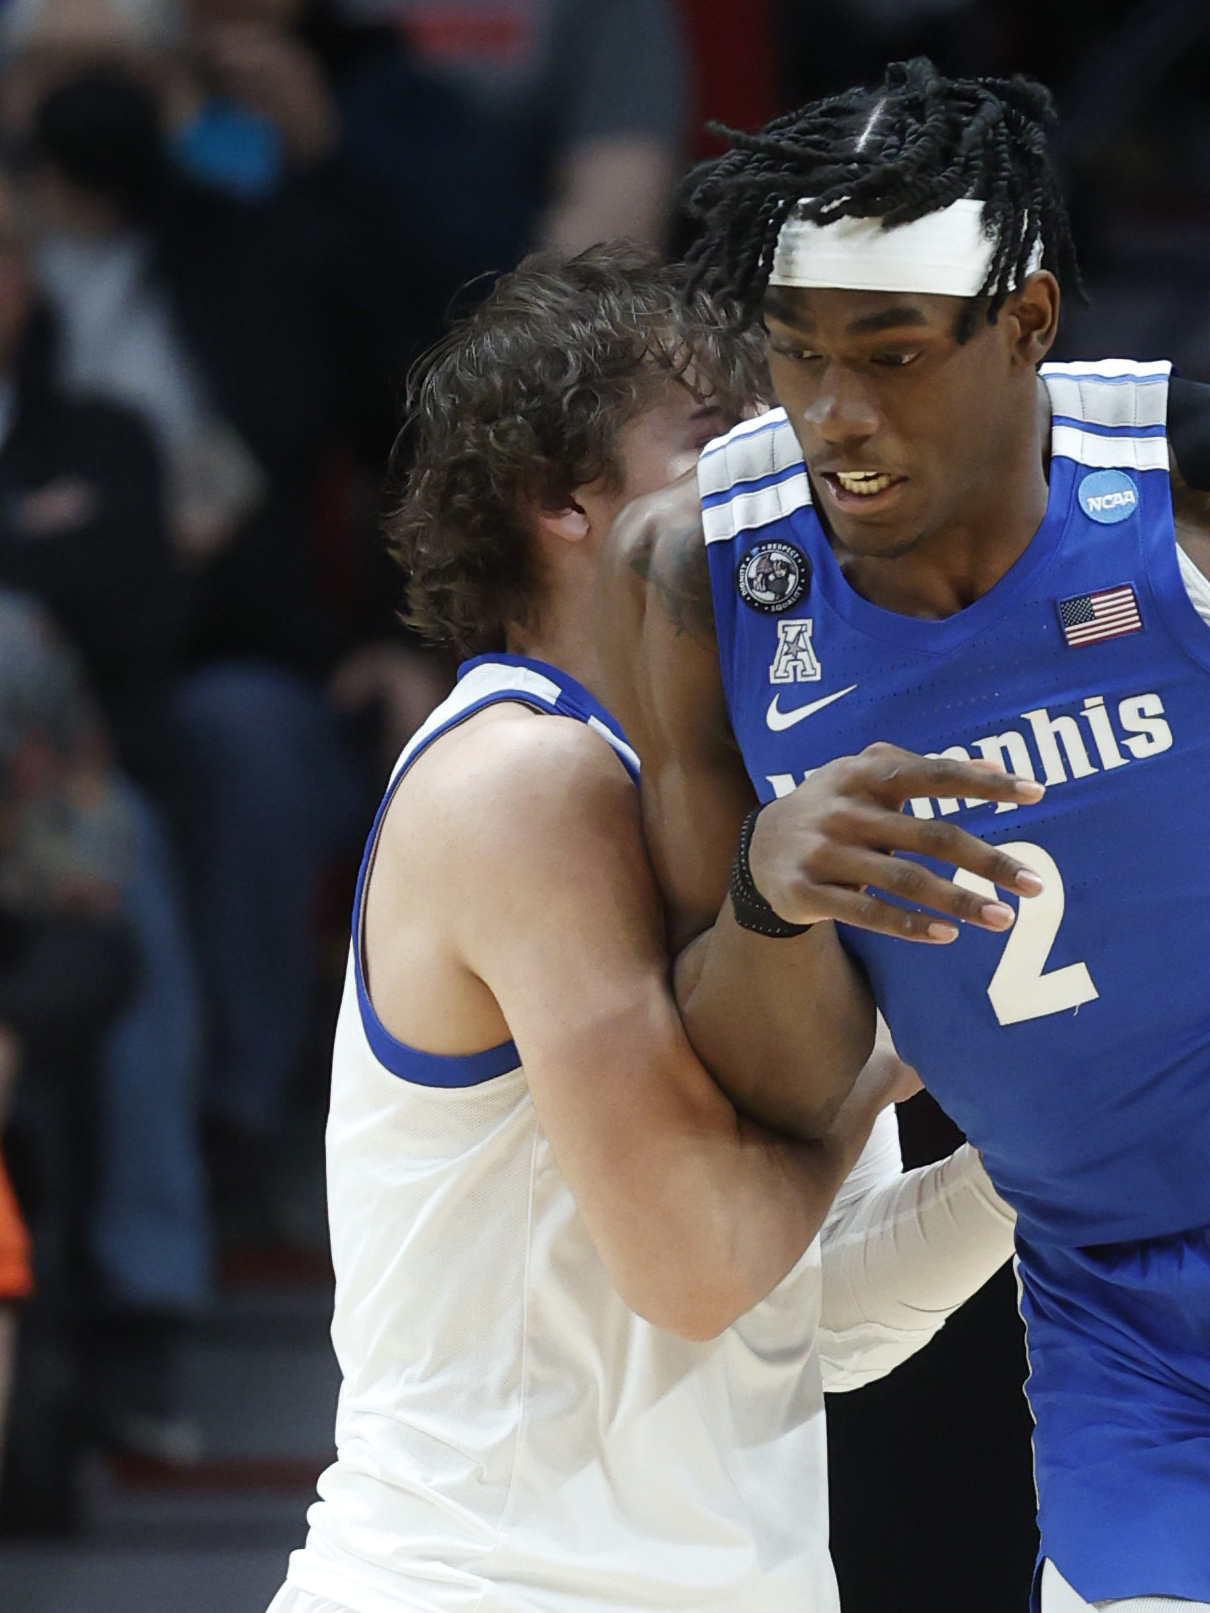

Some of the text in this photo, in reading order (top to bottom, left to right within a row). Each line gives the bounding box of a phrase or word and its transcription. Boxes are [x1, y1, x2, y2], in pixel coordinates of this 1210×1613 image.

[1086, 489, 1136, 512] NCAA
[767, 543, 799, 559] RESPECT
[766, 692, 1174, 820] phis
[953, 841, 1100, 1026] 2
